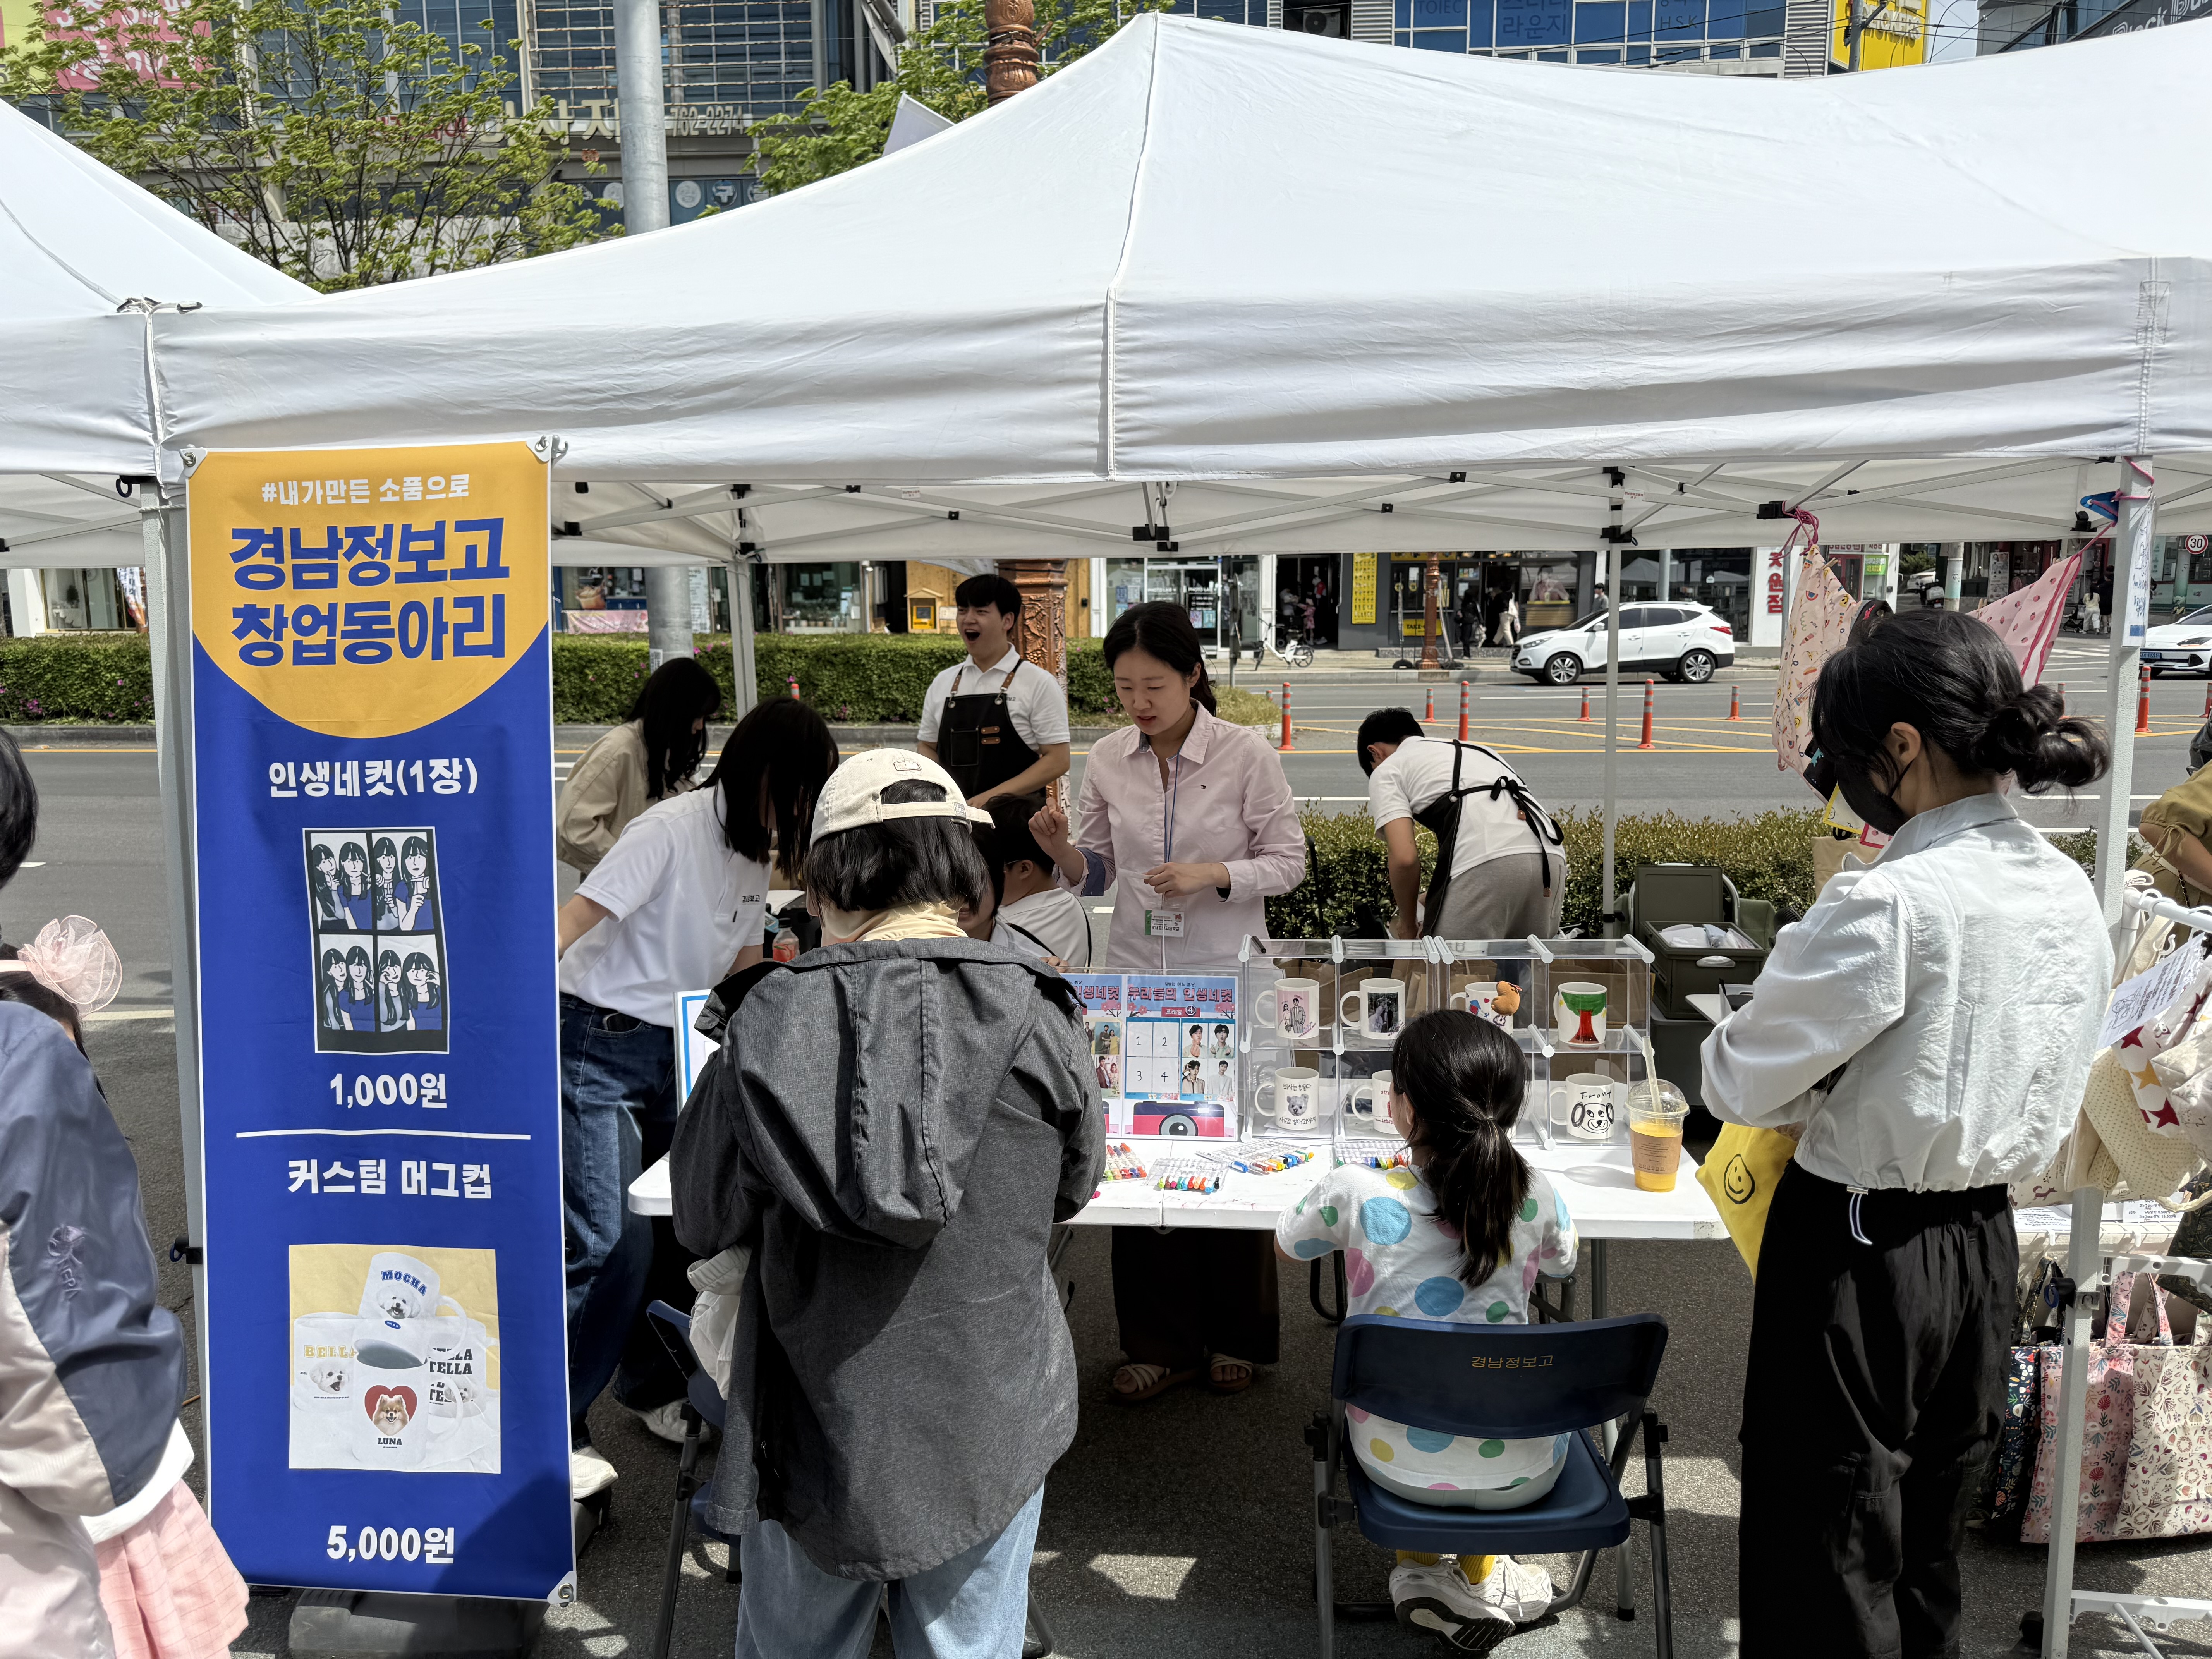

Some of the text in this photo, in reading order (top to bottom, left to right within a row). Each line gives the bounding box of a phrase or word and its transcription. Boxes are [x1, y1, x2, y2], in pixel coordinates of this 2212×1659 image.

[1503, 14, 1565, 39] 라운지
[1661, 15, 1697, 29] HSK
[670, 106, 744, 137] 762-2274
[262, 474, 470, 506] #내가만든 소품으로
[229, 517, 510, 591] 경남정보고
[2190, 538, 2203, 548] 30
[231, 593, 506, 667] 창업동아리
[268, 757, 478, 798] 인생네컷(1장)
[1128, 986, 1233, 1002] 우리들의 인생네컷
[1166, 1008, 1182, 1016] 프레임
[1136, 1036, 1168, 1046] 1 2
[1136, 1071, 1168, 1082] 3 4
[330, 1073, 447, 1109] 1,000원
[1580, 1089, 1611, 1099] Front
[288, 1159, 492, 1199] 커스텀 머그컵
[381, 1270, 427, 1297] MOCHA
[1472, 1355, 1553, 1369] 경남정보고
[326, 1525, 455, 1564] 5,000원
